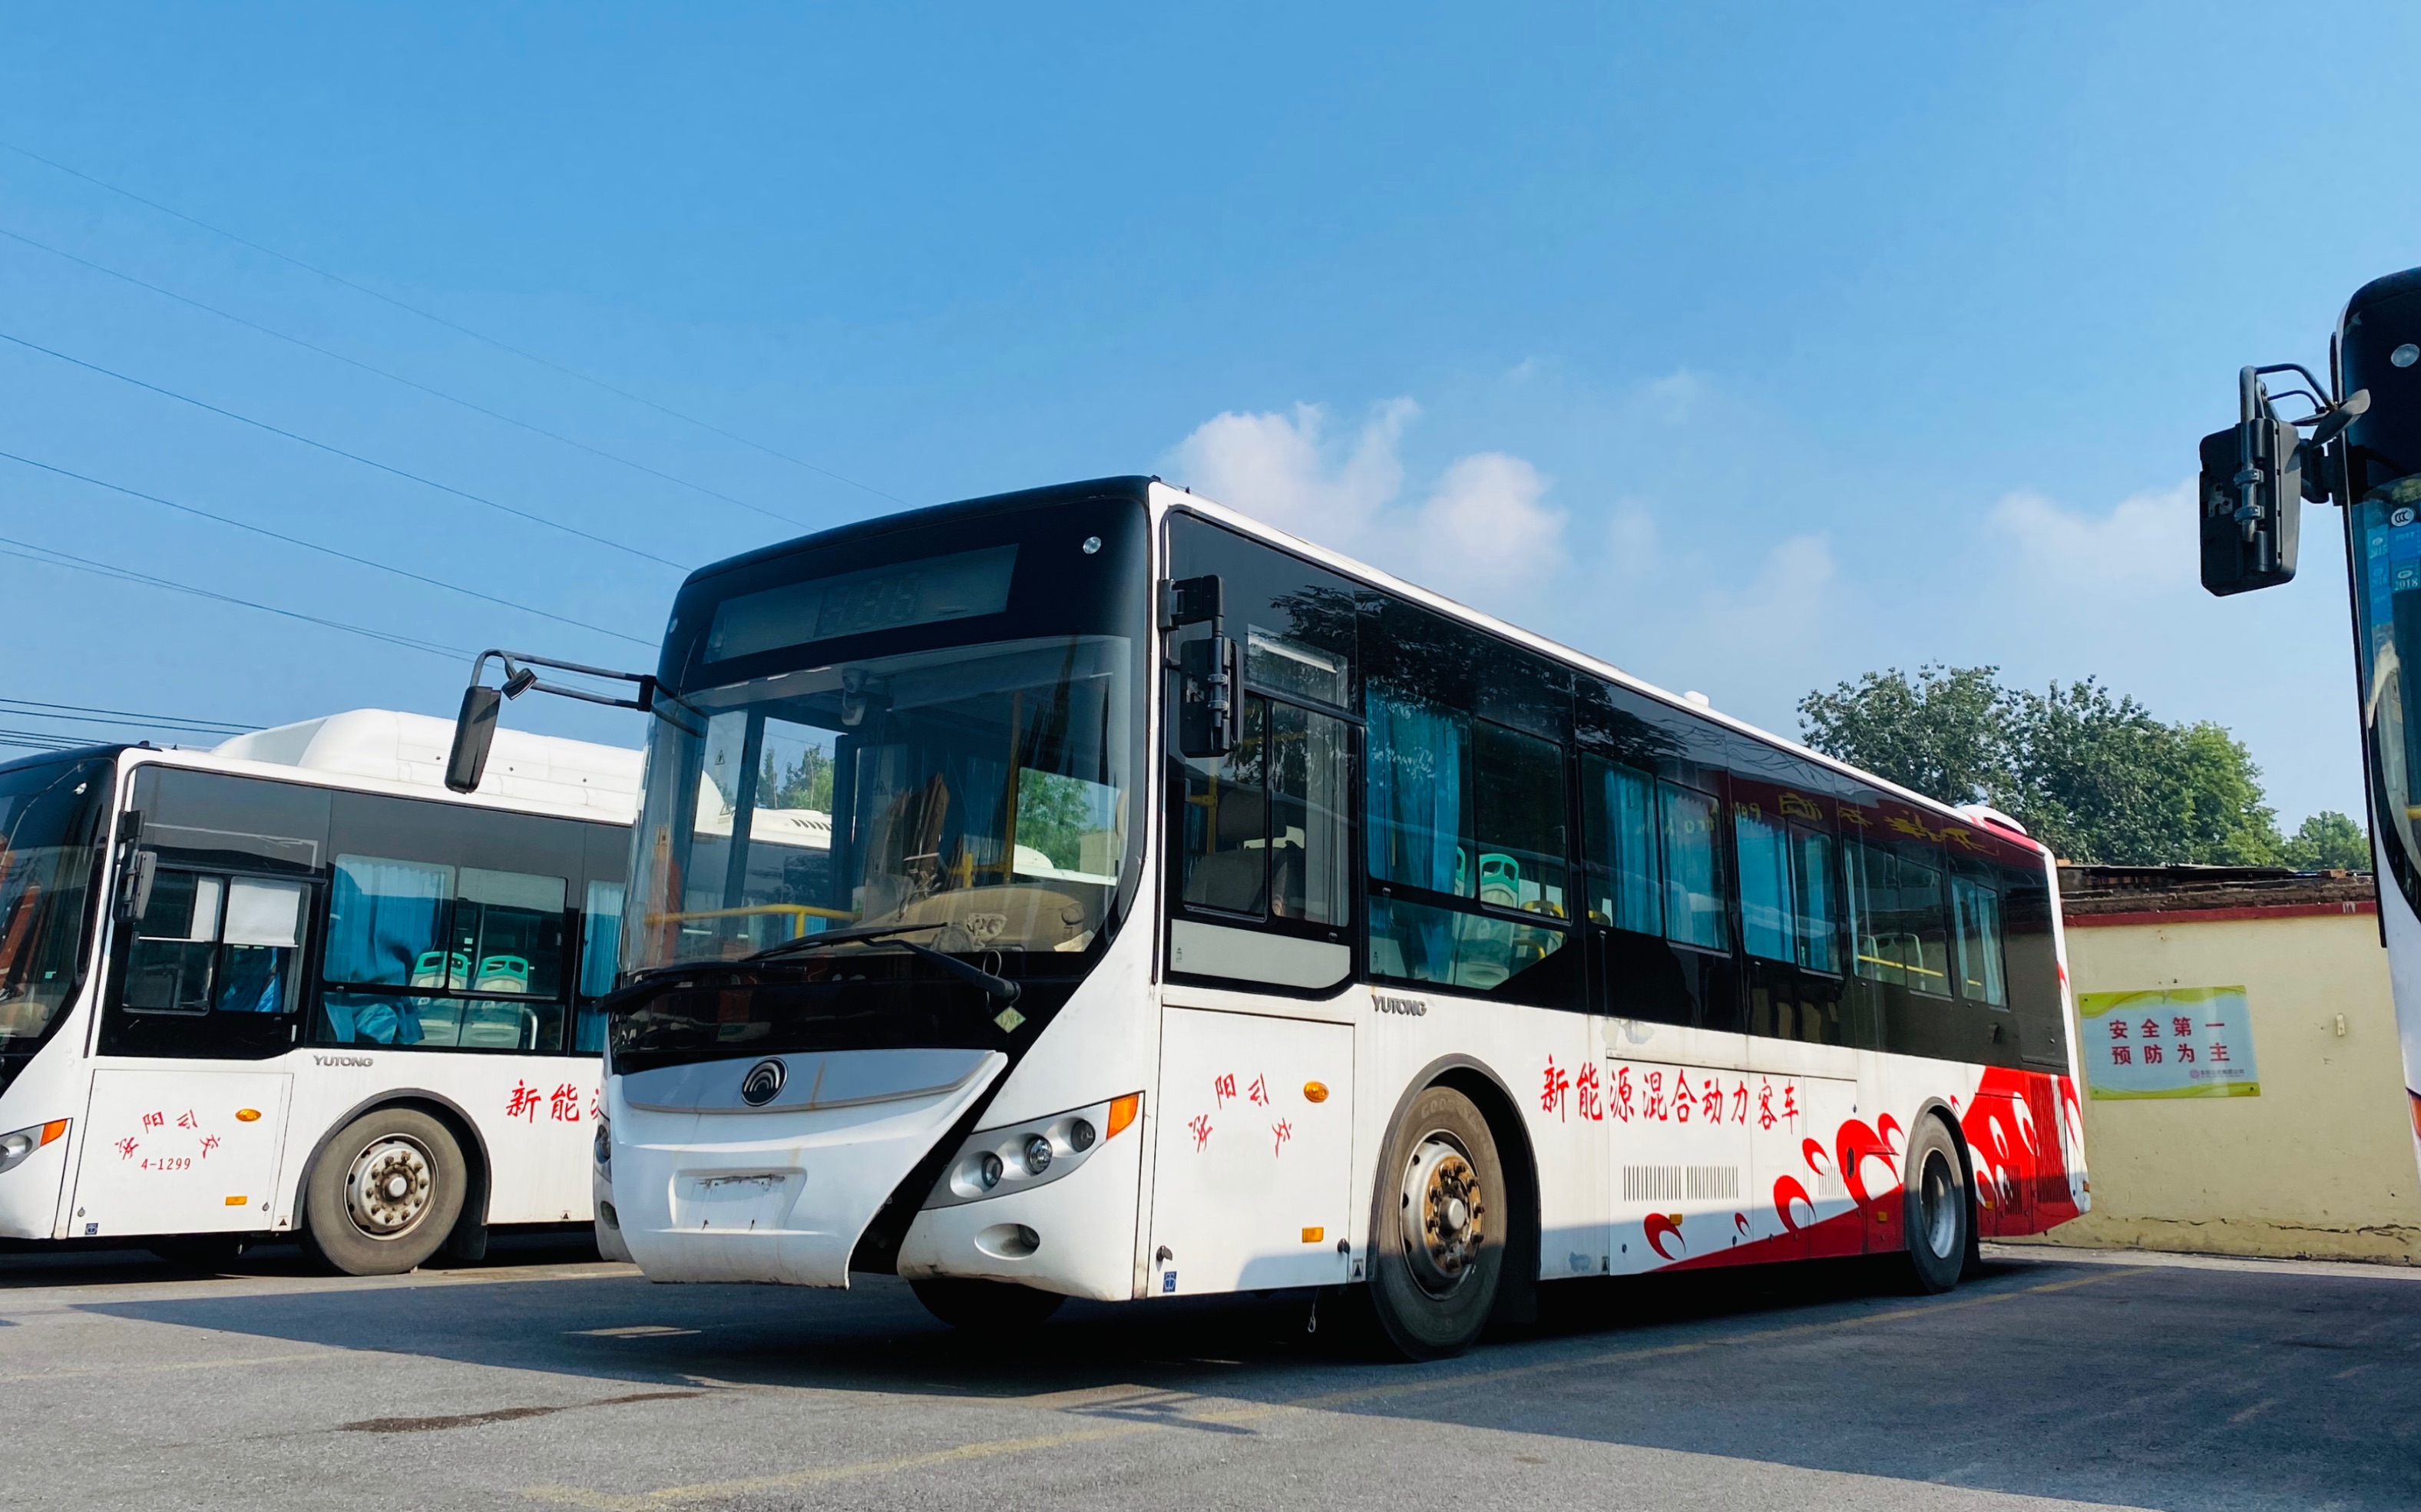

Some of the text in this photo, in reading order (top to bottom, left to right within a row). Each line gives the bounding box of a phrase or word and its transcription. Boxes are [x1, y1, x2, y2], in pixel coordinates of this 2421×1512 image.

[2394, 577, 2418, 591] 2018
[1371, 994, 1427, 1017] YUTONG
[2109, 1017, 2224, 1039] 安全第一
[313, 1054, 374, 1067] YUTONG
[2112, 1043, 2230, 1065] 预防为主
[1540, 1054, 1799, 1135] 新能源混合动力客车
[1188, 1072, 1292, 1159] 安阳公交
[114, 1109, 221, 1160] 安阳公交
[141, 1157, 191, 1170] 4-1299
